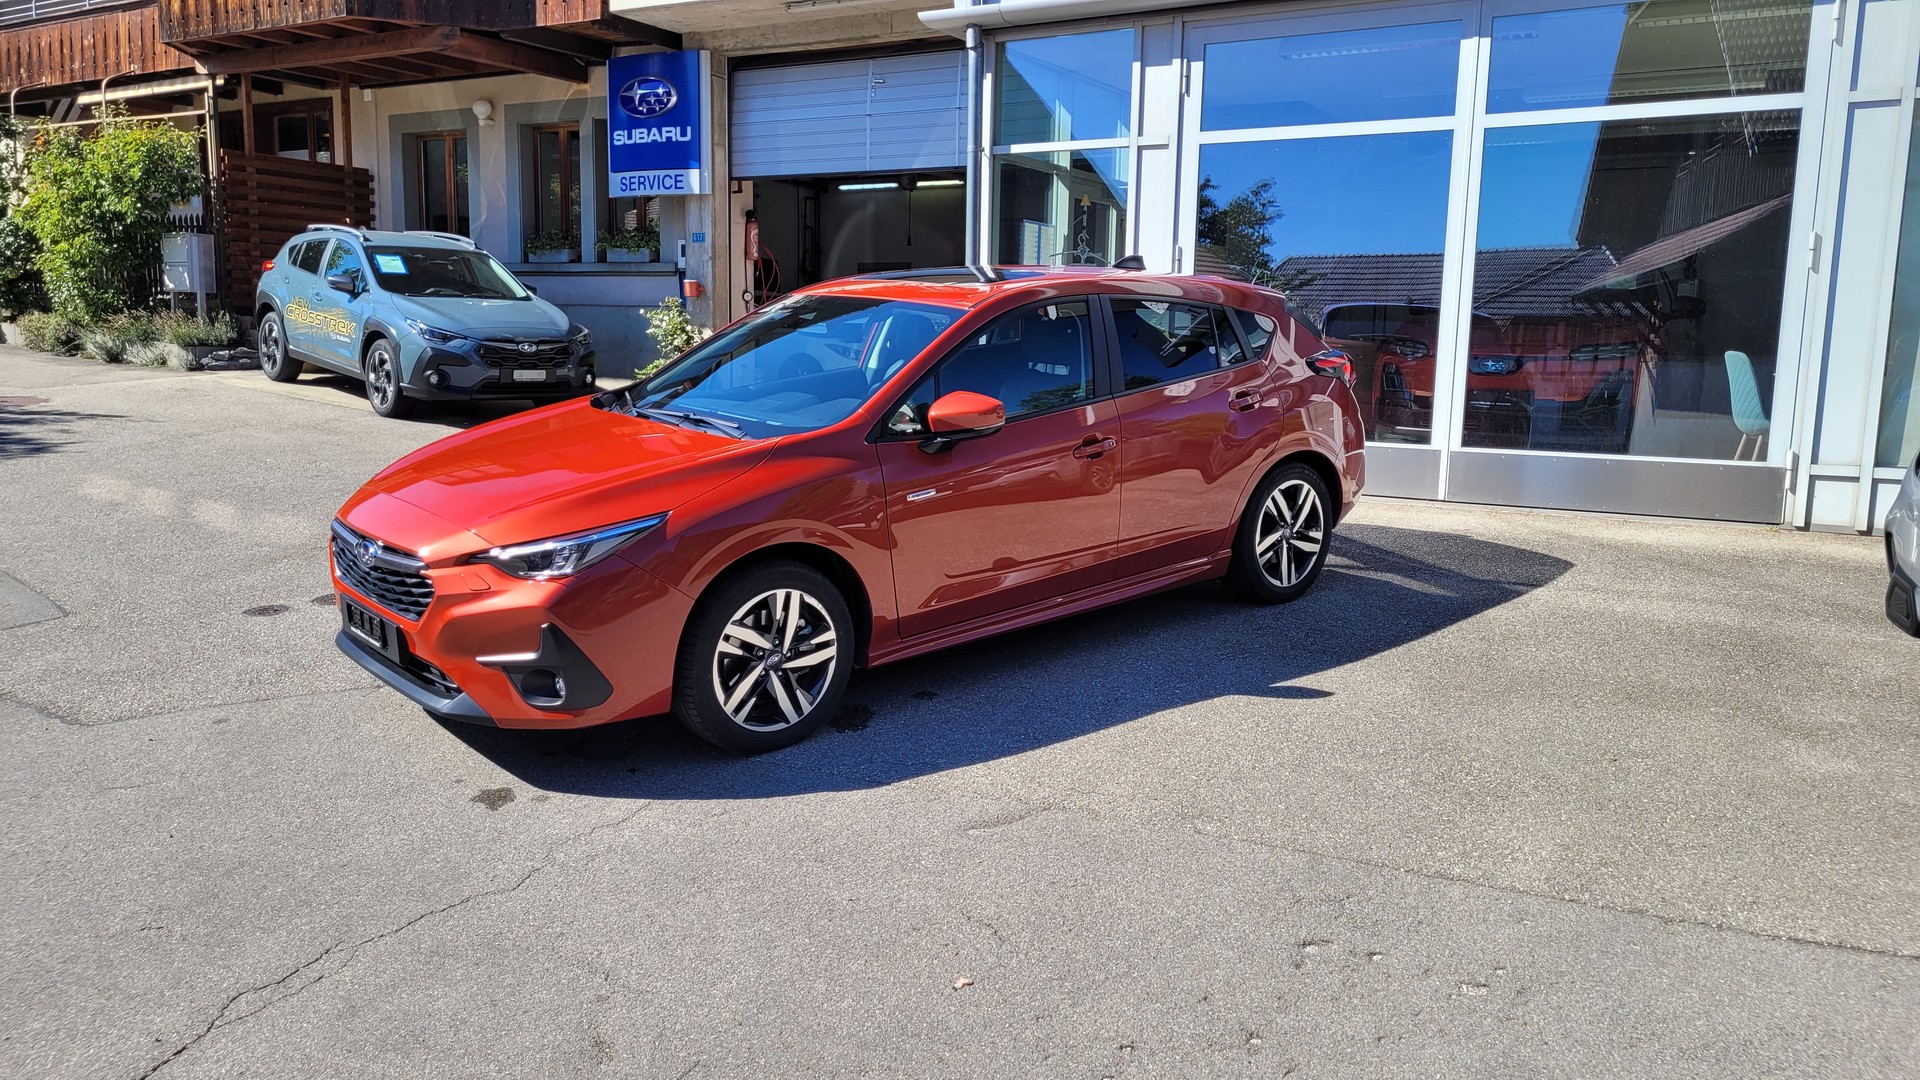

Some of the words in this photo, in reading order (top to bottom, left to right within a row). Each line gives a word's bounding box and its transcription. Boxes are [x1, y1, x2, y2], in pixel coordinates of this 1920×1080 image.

[613, 126, 691, 145] SUBARU
[620, 174, 684, 192] SERVICE
[291, 295, 311, 310] NEW
